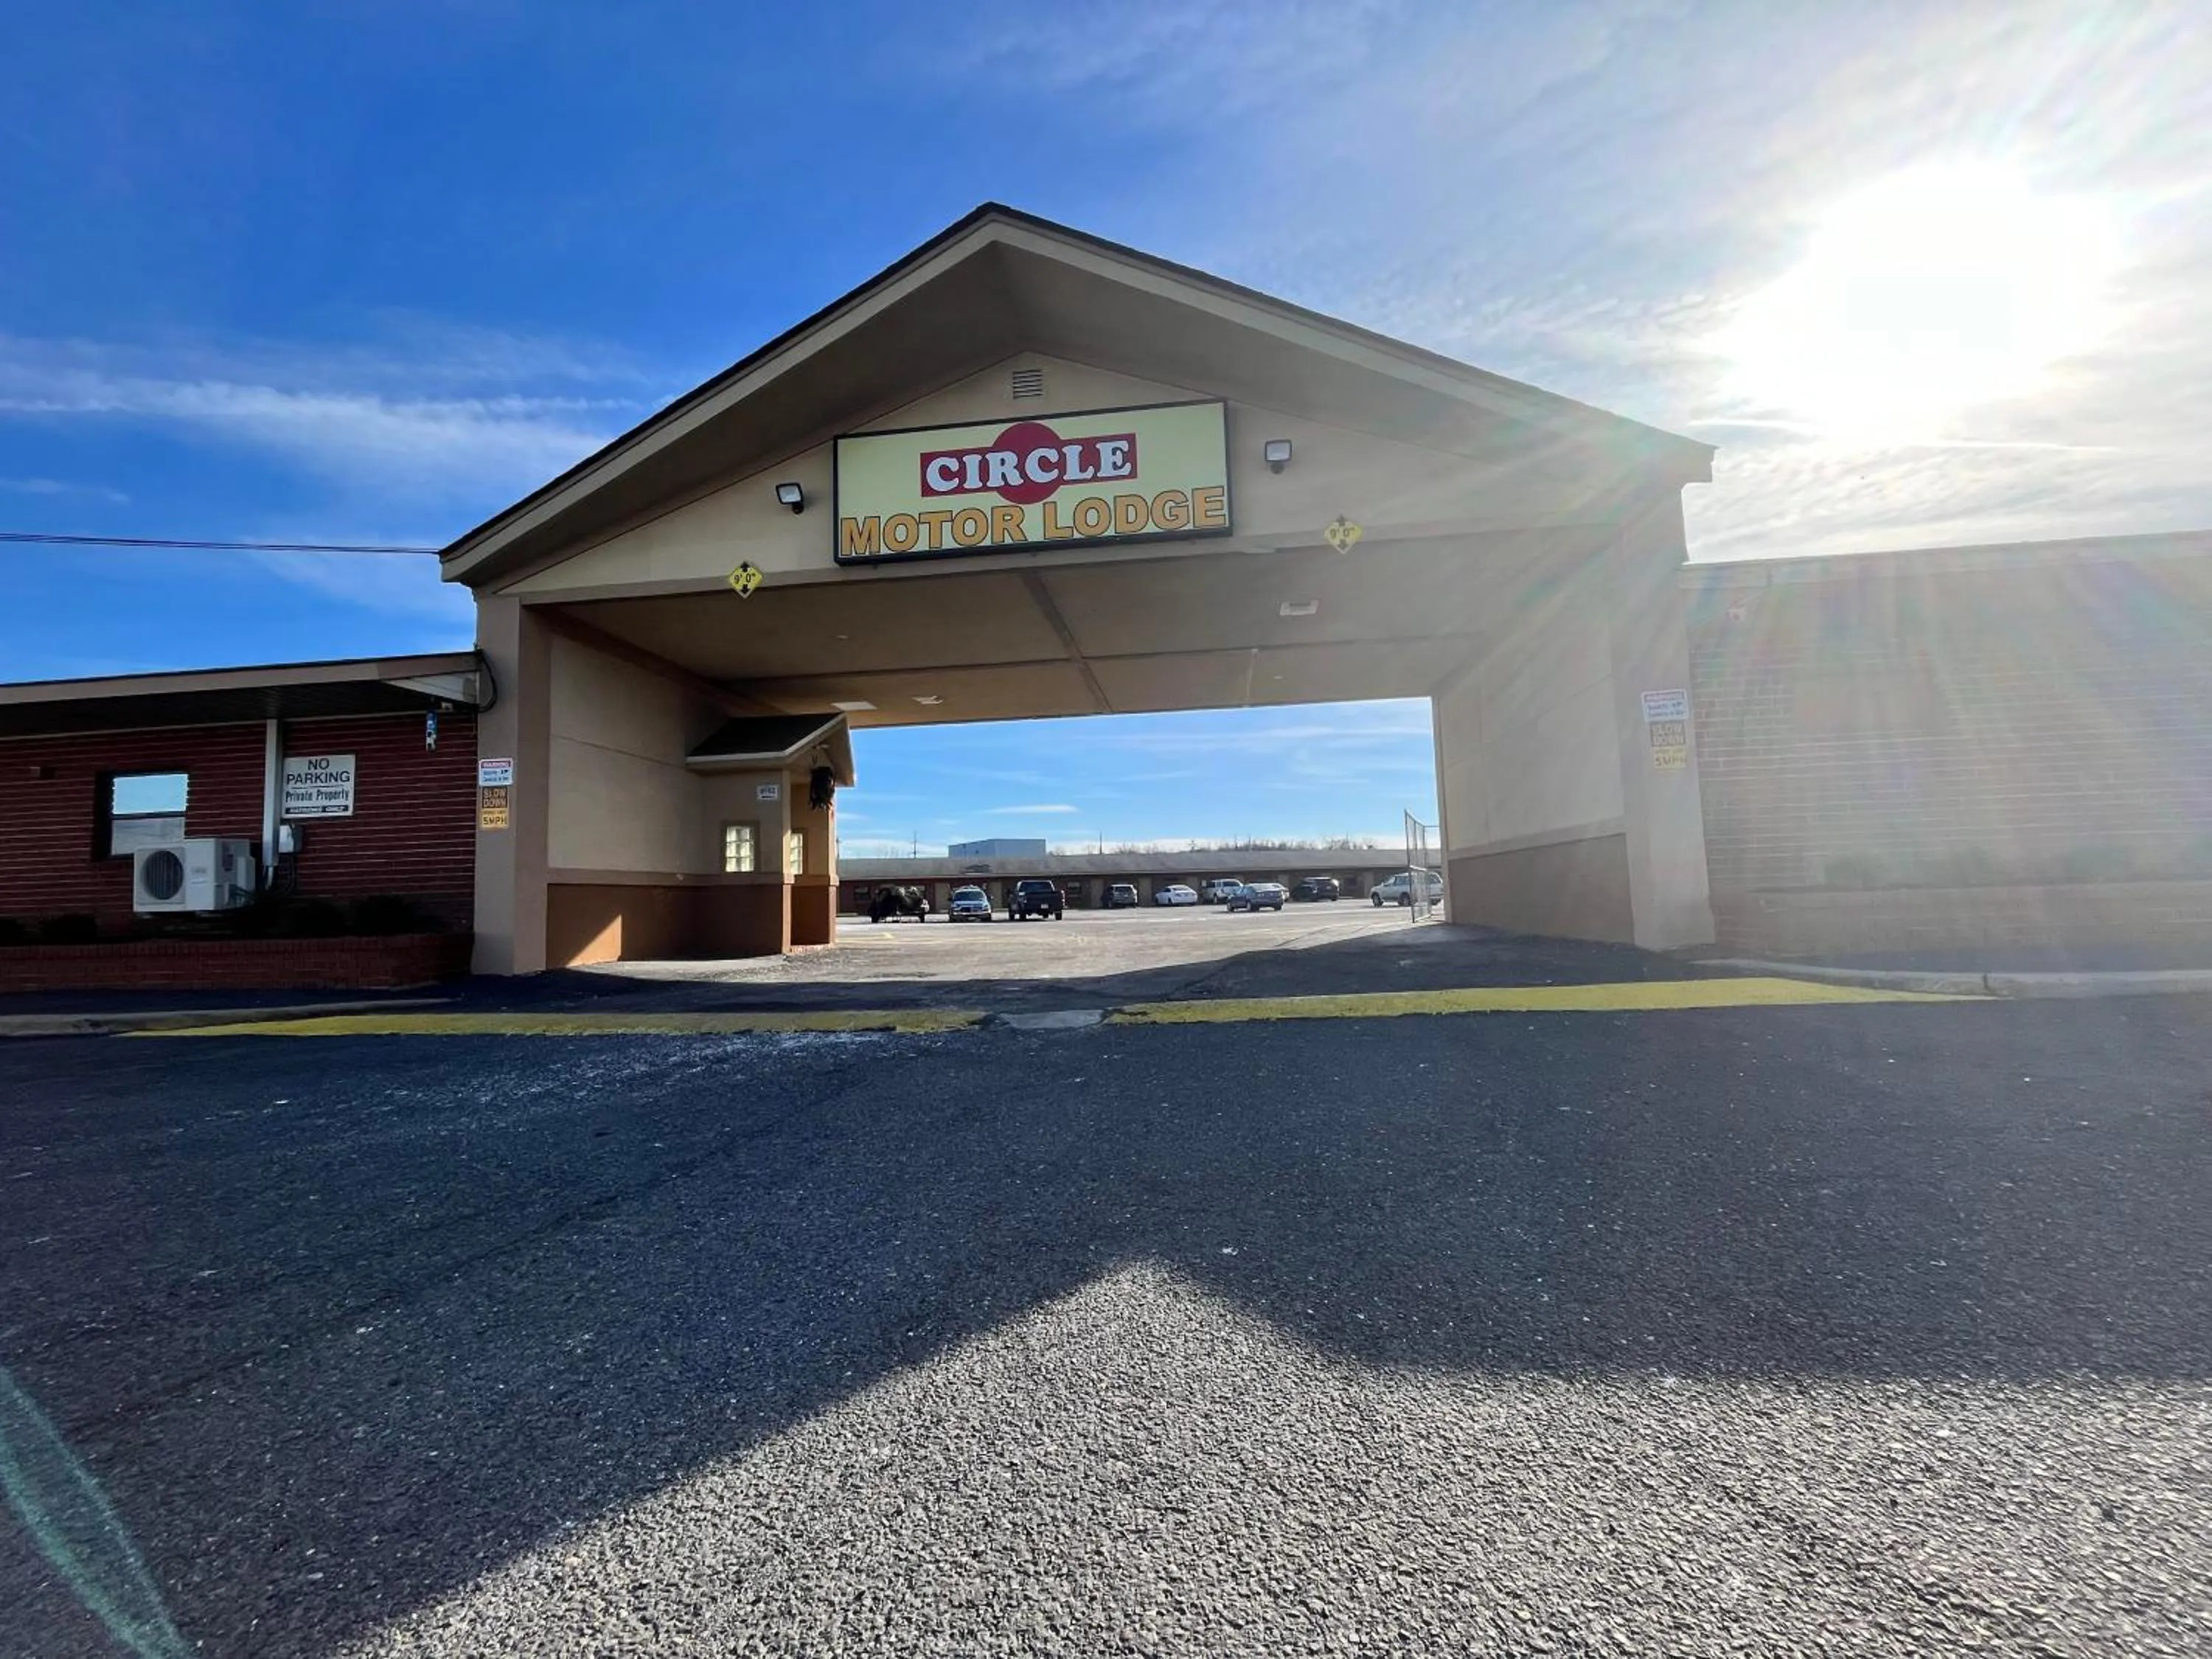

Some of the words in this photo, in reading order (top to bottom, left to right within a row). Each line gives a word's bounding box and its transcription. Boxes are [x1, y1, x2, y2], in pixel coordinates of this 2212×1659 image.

[925, 440, 1130, 493] CIRCLE
[840, 504, 1027, 556] MOTOR
[1043, 486, 1226, 540] LODGE
[307, 758, 330, 770] NO
[286, 771, 350, 785] PARKING
[285, 790, 313, 802] Private
[316, 788, 349, 802] Property
[483, 787, 507, 798] SLOW
[483, 799, 507, 808] DOWN
